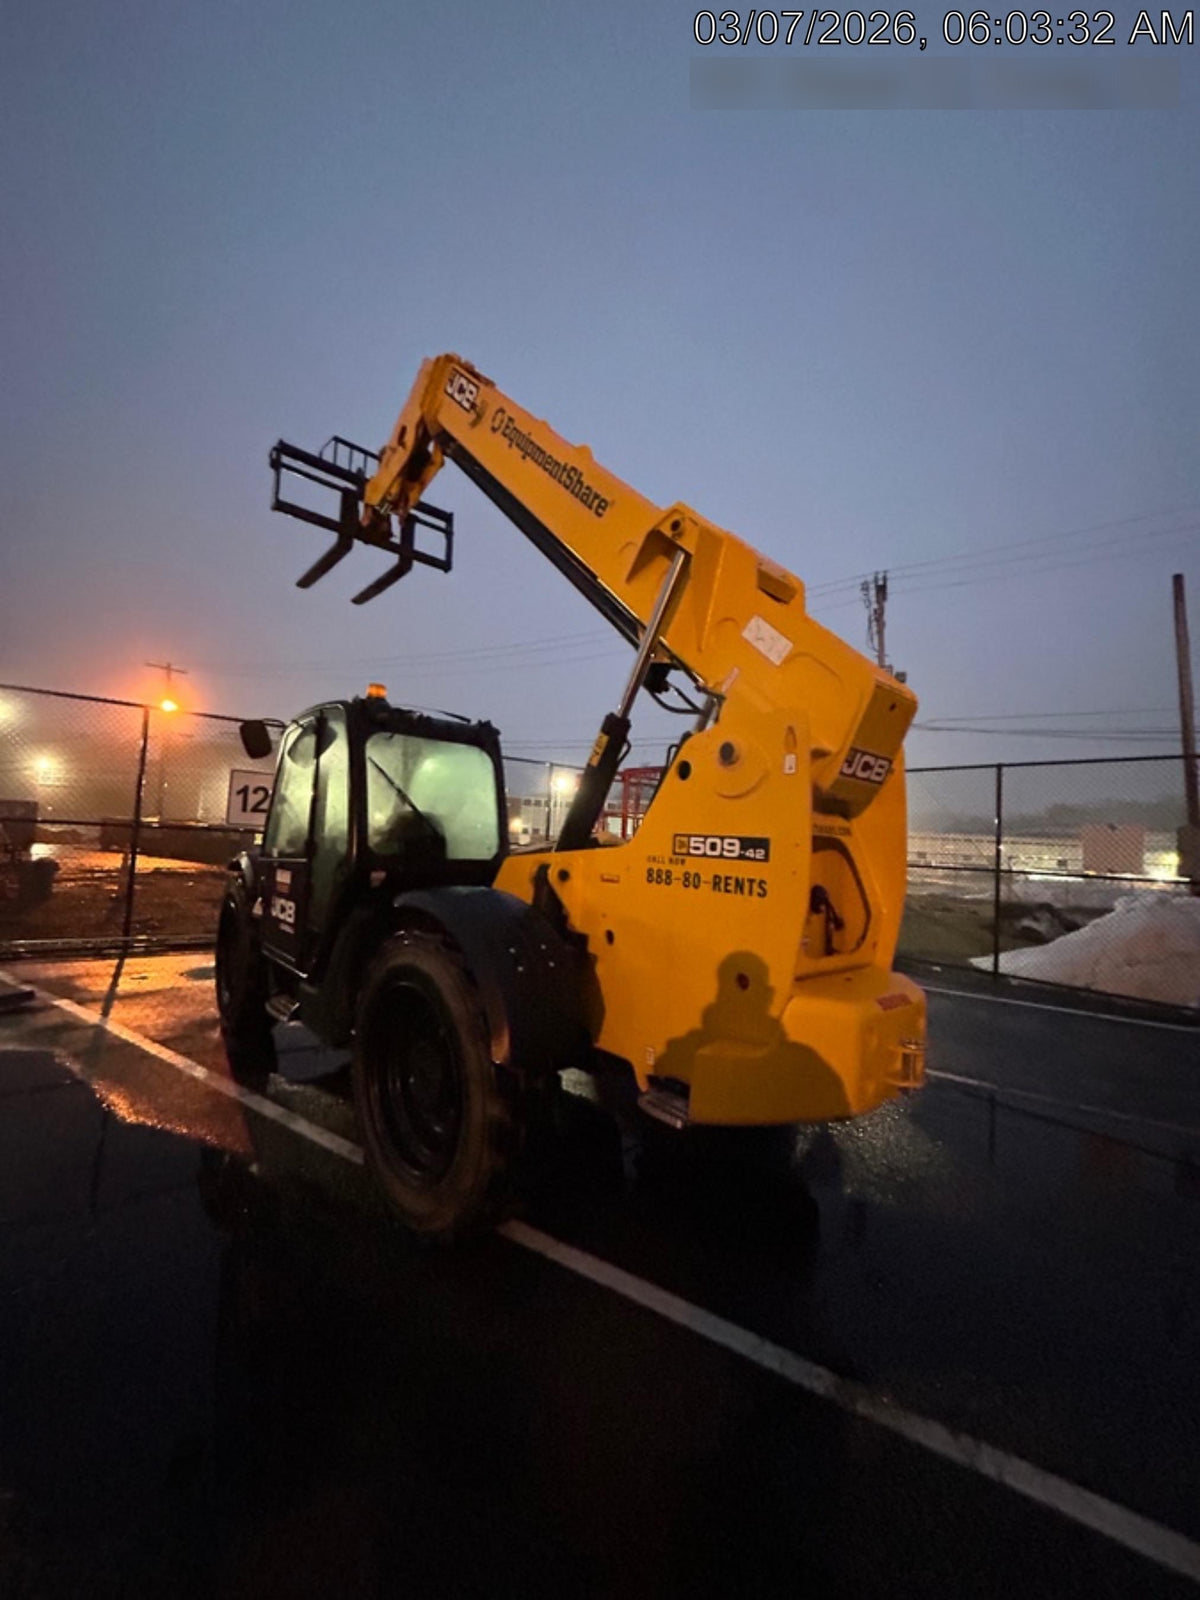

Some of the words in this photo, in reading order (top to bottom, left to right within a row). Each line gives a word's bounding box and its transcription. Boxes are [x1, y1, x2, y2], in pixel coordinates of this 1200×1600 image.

[446, 373, 478, 410] JCB
[501, 415, 609, 517] EquipmentShare
[841, 752, 892, 782] JCB
[271, 897, 296, 923] JCB
